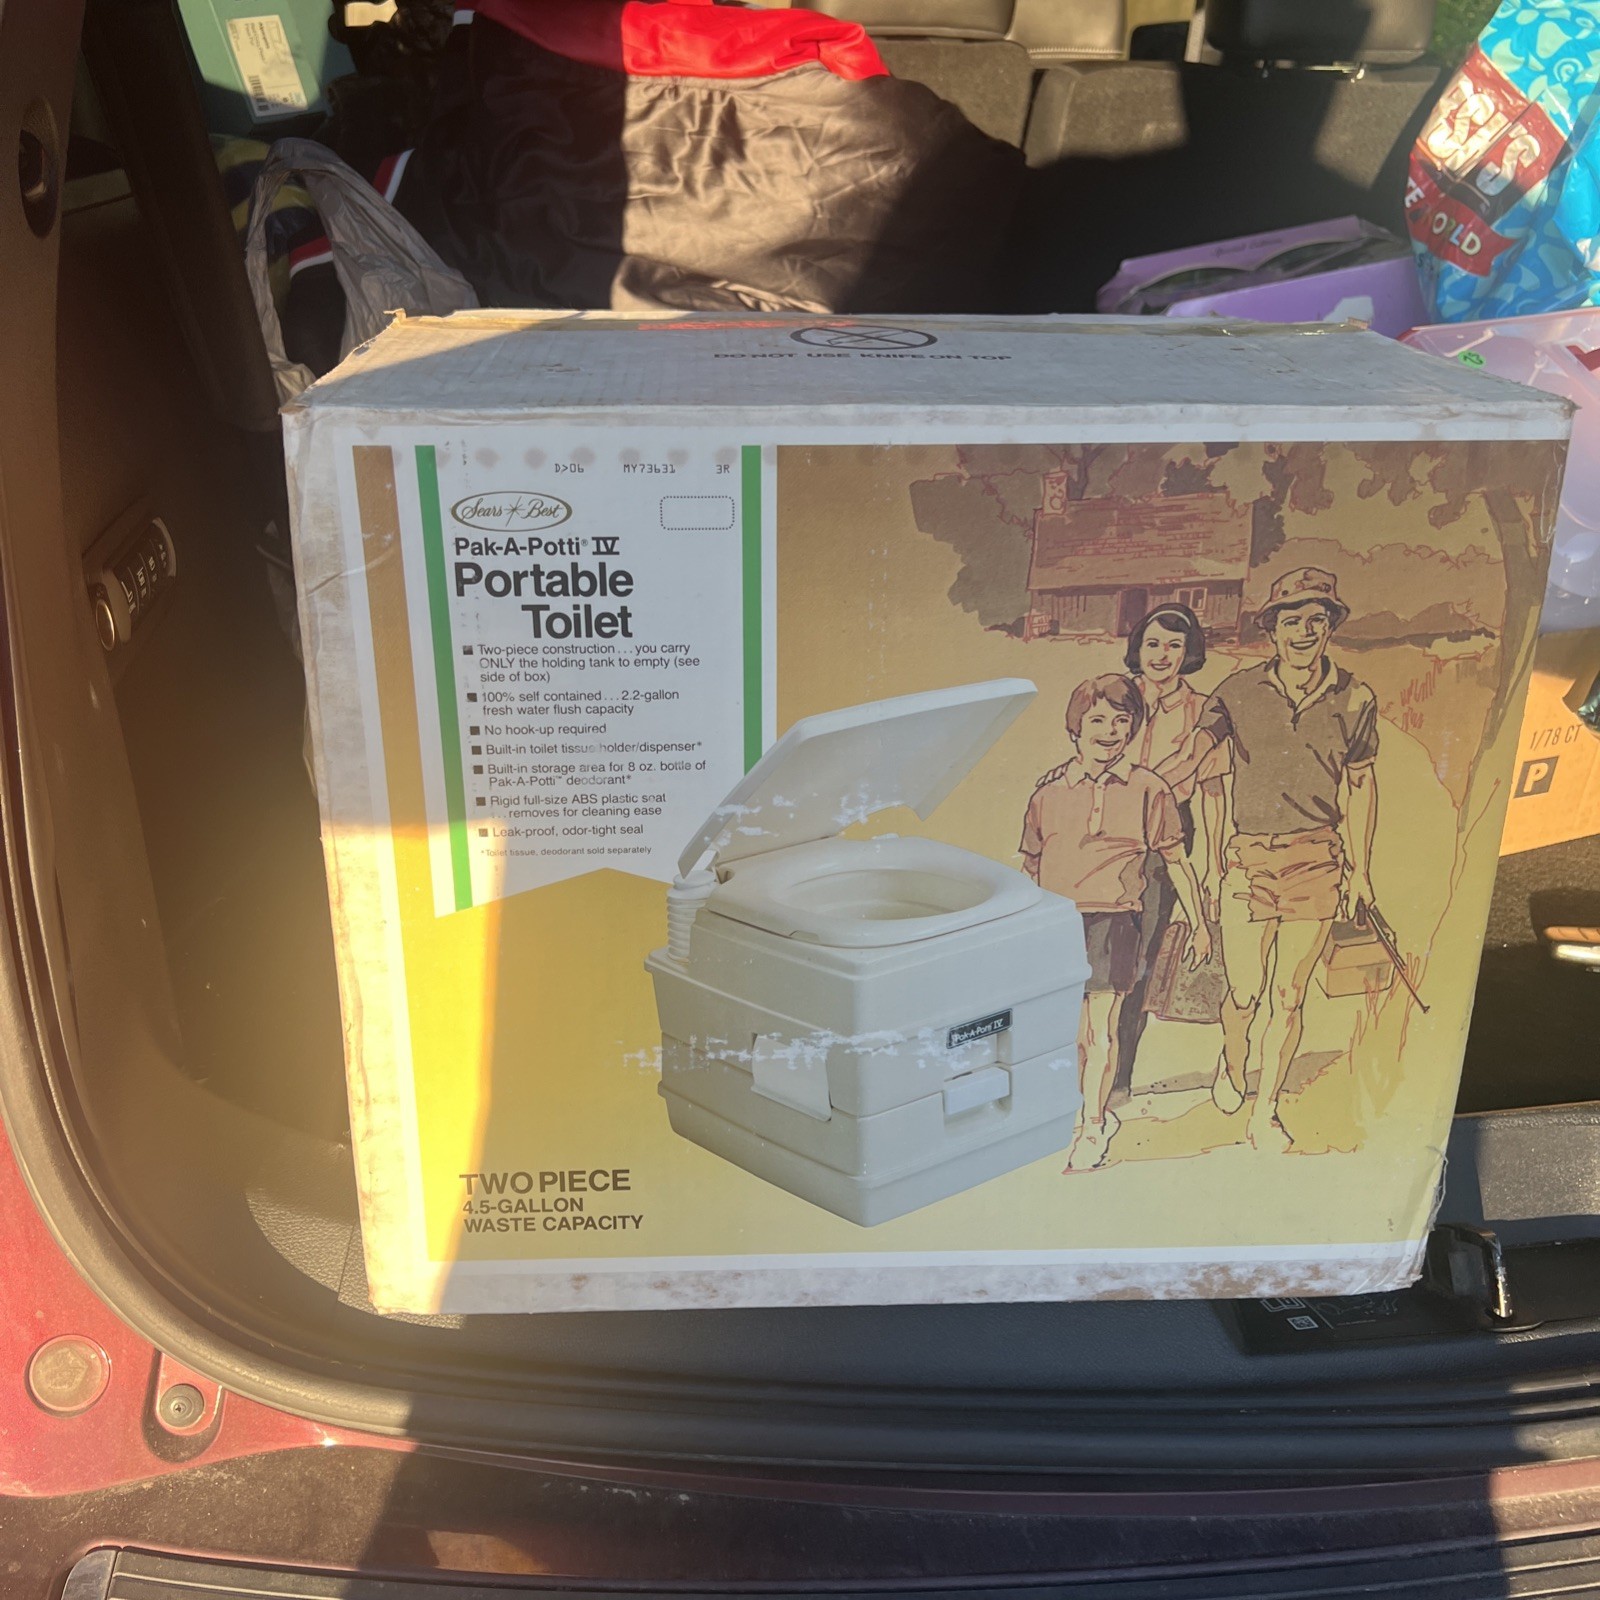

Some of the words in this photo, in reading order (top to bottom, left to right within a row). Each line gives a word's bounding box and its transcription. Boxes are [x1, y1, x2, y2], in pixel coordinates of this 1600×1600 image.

[461, 498, 502, 520] Sears
[520, 498, 564, 520] Best
[592, 536, 620, 555] IV
[454, 562, 634, 598] Portable
[521, 604, 633, 639] Toilet
[477, 644, 538, 656] Two-piece
[660, 644, 690, 656] carry
[480, 658, 515, 668] ONLY
[519, 658, 538, 668] the
[542, 657, 586, 670] holding
[590, 657, 615, 668] tank
[618, 657, 630, 667] to
[634, 657, 670, 669] empty
[674, 656, 700, 668] (see
[480, 672, 505, 682] side
[509, 672, 520, 682] of
[524, 672, 551, 683] box)
[482, 692, 515, 702] 100%
[519, 691, 540, 702] self
[483, 705, 513, 715] fresh
[517, 706, 549, 715] water
[554, 704, 582, 714] flush
[586, 704, 634, 716] capacity
[484, 725, 502, 735] No
[506, 724, 554, 736] hook-up
[558, 724, 606, 736] required
[1530, 728, 1562, 751] 1/78
[486, 744, 526, 755] Built-in
[530, 744, 558, 754] toilet
[488, 764, 528, 774] Built-in
[532, 764, 575, 775] storage
[580, 764, 606, 772] area
[609, 762, 623, 772] for
[628, 762, 635, 772] 8
[639, 763, 656, 771] oz.
[660, 760, 691, 771] bottle
[695, 760, 706, 770] of
[1523, 762, 1549, 793] P
[490, 796, 520, 808] Rigid
[524, 795, 568, 805] full-size
[572, 794, 598, 804] ABS
[602, 794, 638, 805] plastic
[642, 793, 666, 803] seat
[564, 807, 578, 817] for
[582, 807, 630, 818] cleaning
[634, 807, 662, 815] ease
[493, 826, 558, 838] Leak-proof,
[562, 825, 616, 837] odor-tight
[620, 824, 644, 834] seal
[608, 846, 652, 855] separately
[459, 1172, 533, 1195] TWO
[540, 1169, 631, 1193] PIECE
[462, 1198, 583, 1214] 4.5-GALLON
[464, 1217, 536, 1232] WASTE
[542, 1215, 644, 1232] CAPACITY
